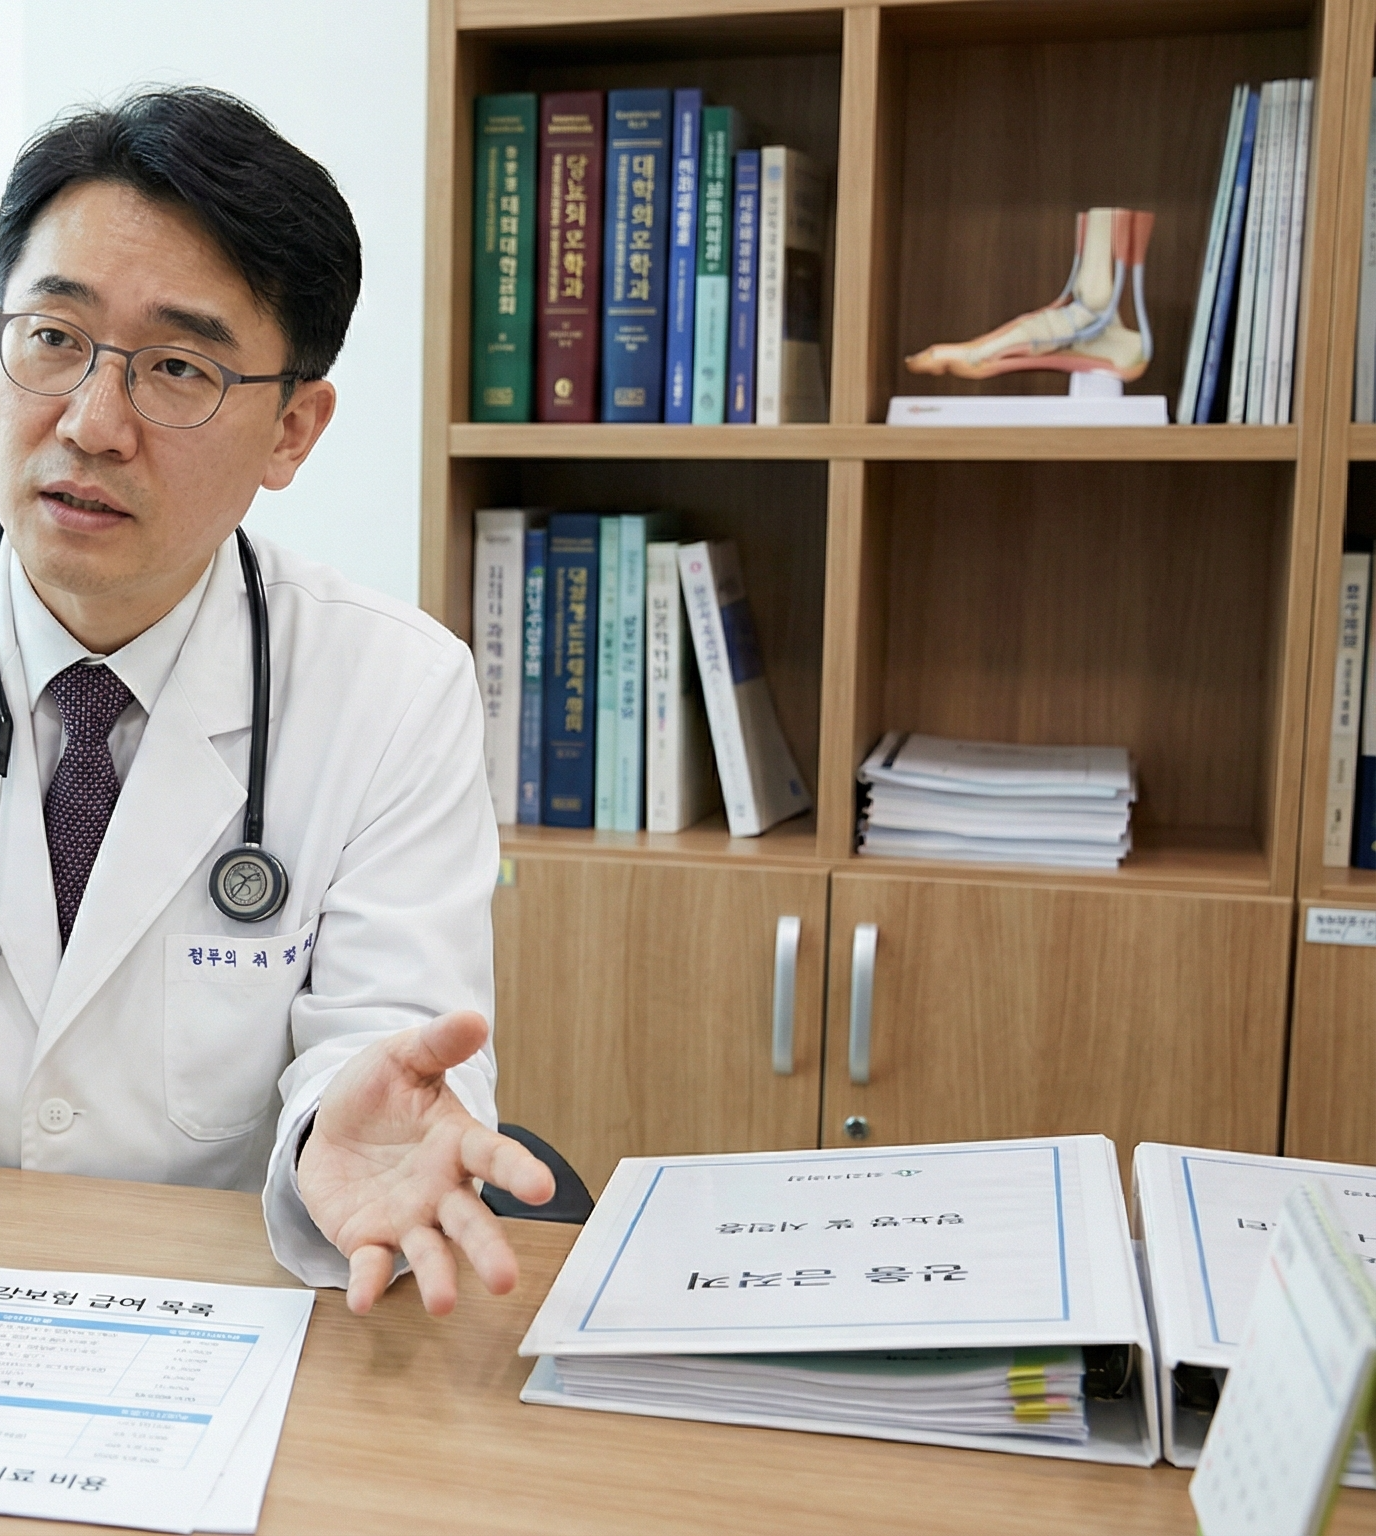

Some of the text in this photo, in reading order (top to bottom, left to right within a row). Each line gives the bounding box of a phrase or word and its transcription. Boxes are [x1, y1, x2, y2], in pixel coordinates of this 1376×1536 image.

[88, 1293, 147, 1312] 급여
[156, 1299, 215, 1318] 목록
[49, 1472, 109, 1492] 비용
